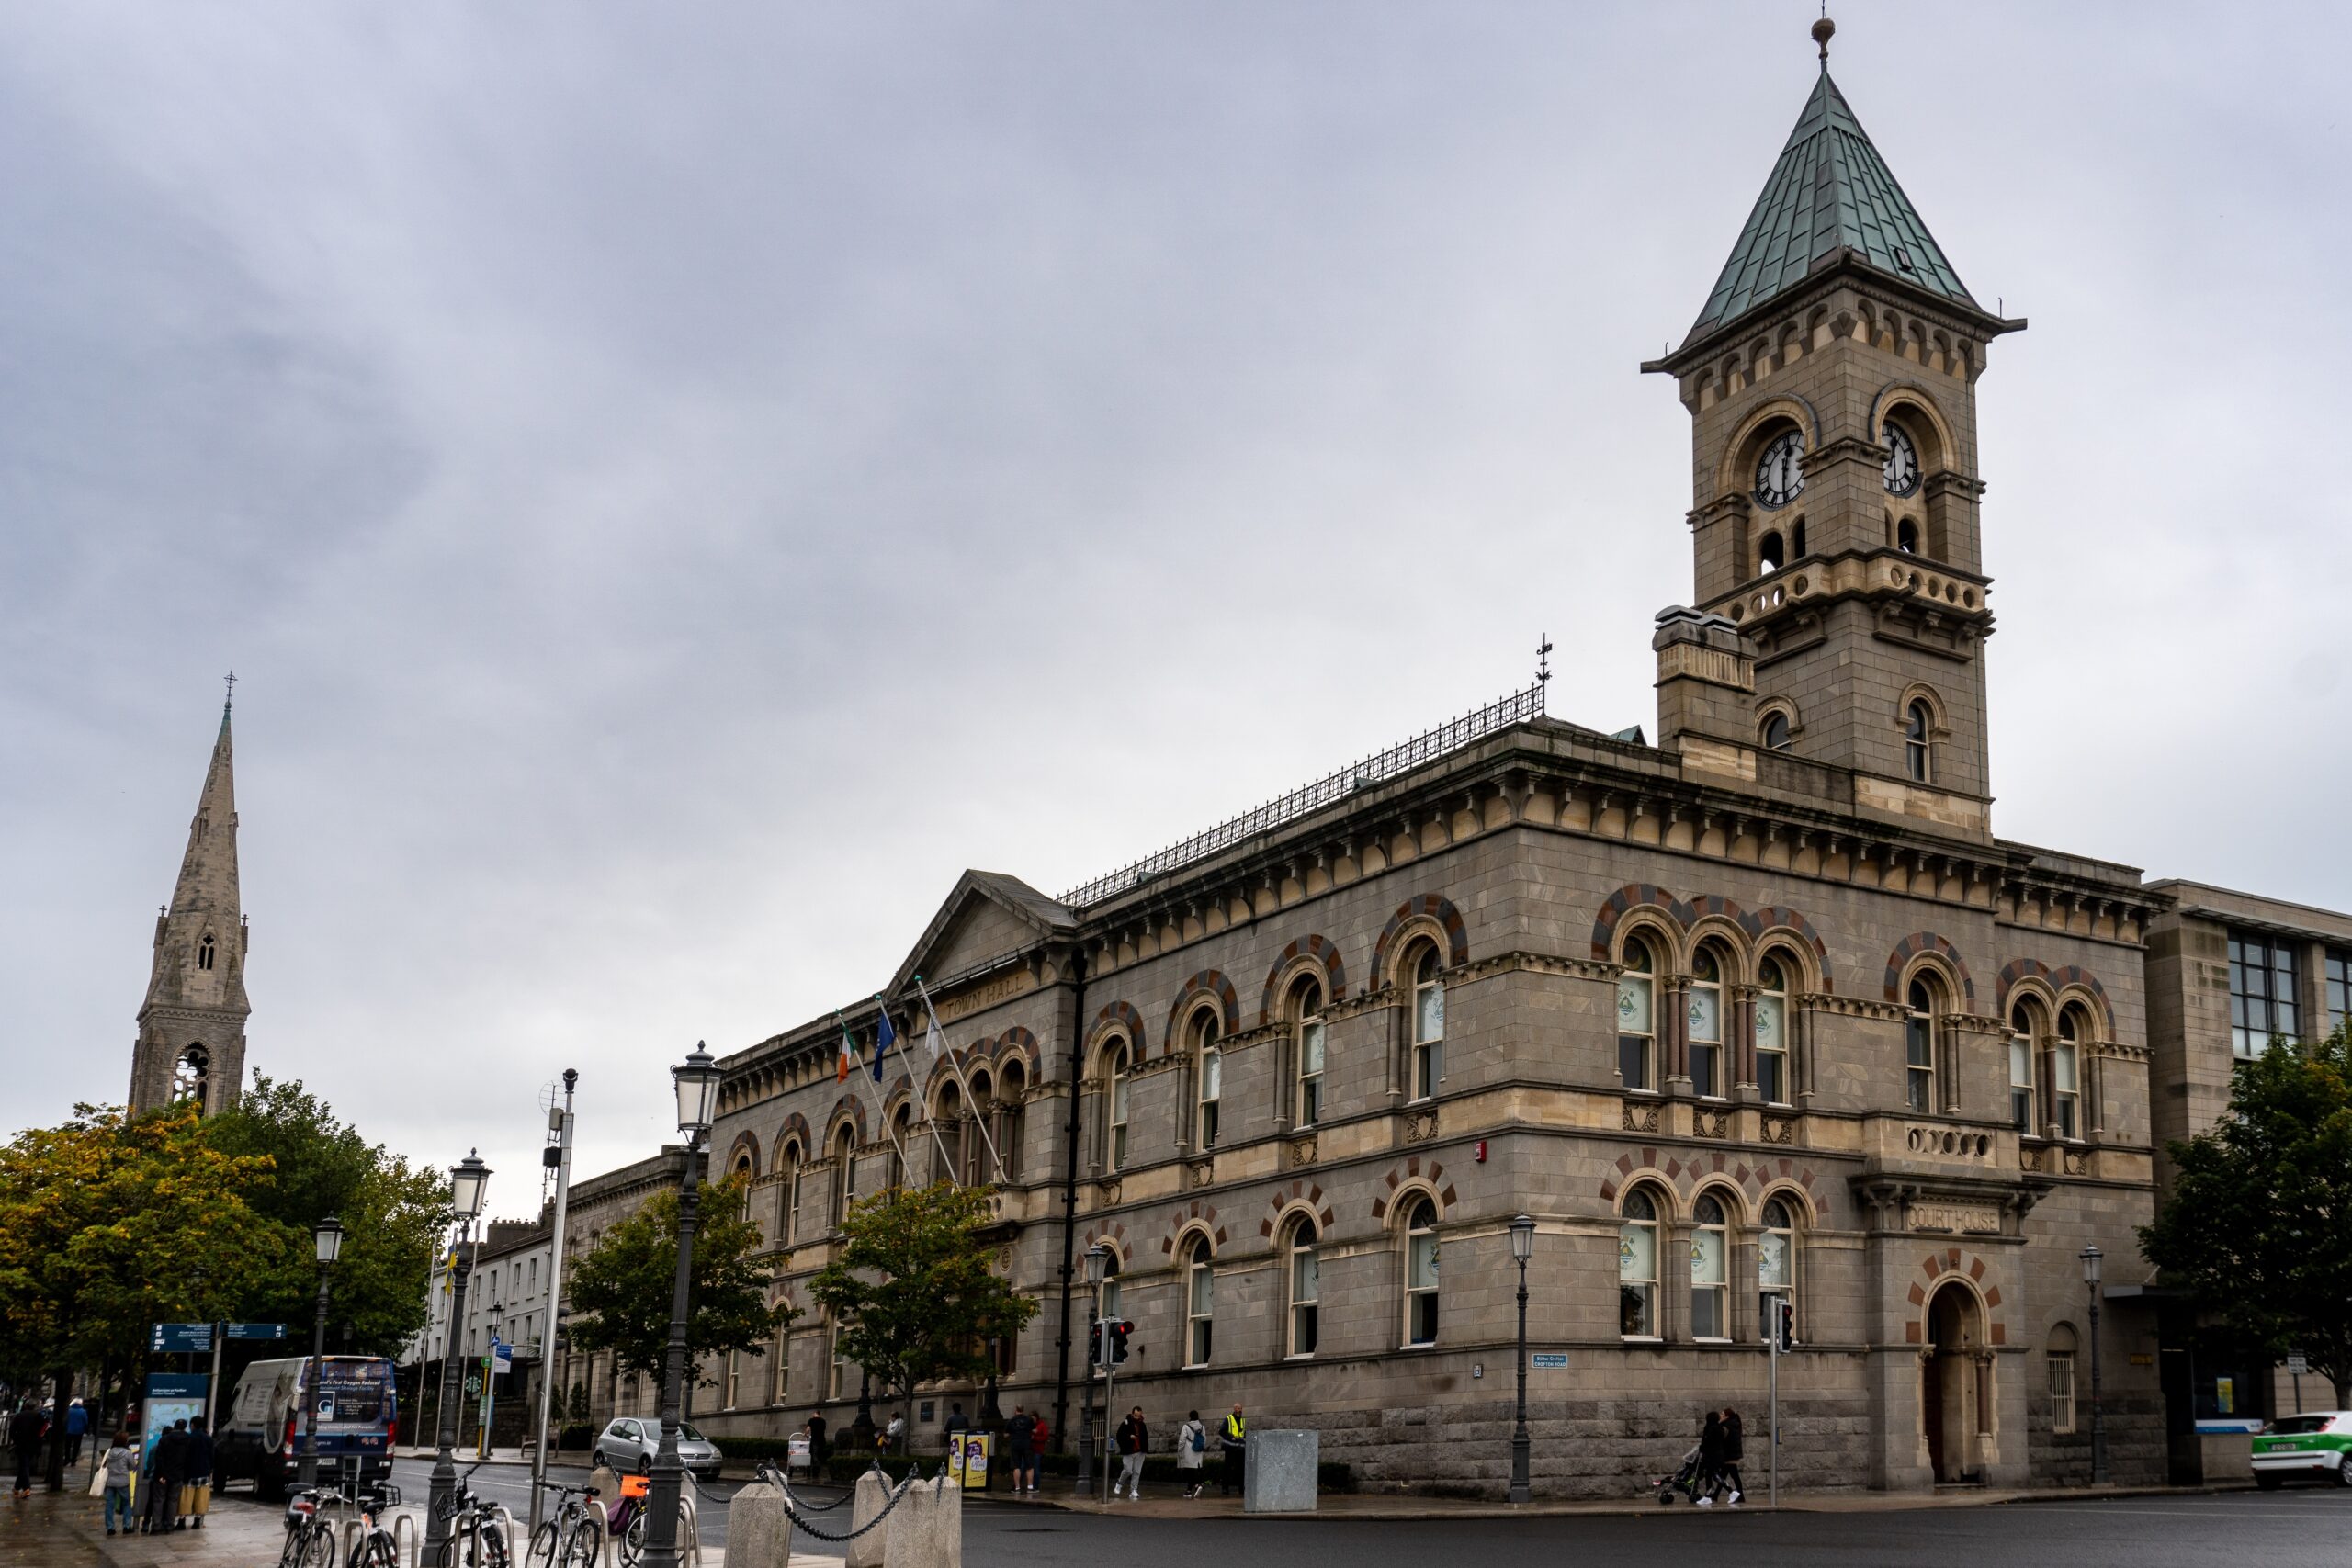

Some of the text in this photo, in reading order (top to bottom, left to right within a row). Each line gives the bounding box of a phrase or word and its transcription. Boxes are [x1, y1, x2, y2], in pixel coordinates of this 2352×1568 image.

[947, 976, 1023, 1019] TOWN HALL
[1909, 1207, 1997, 1230] COURT HOUSE
